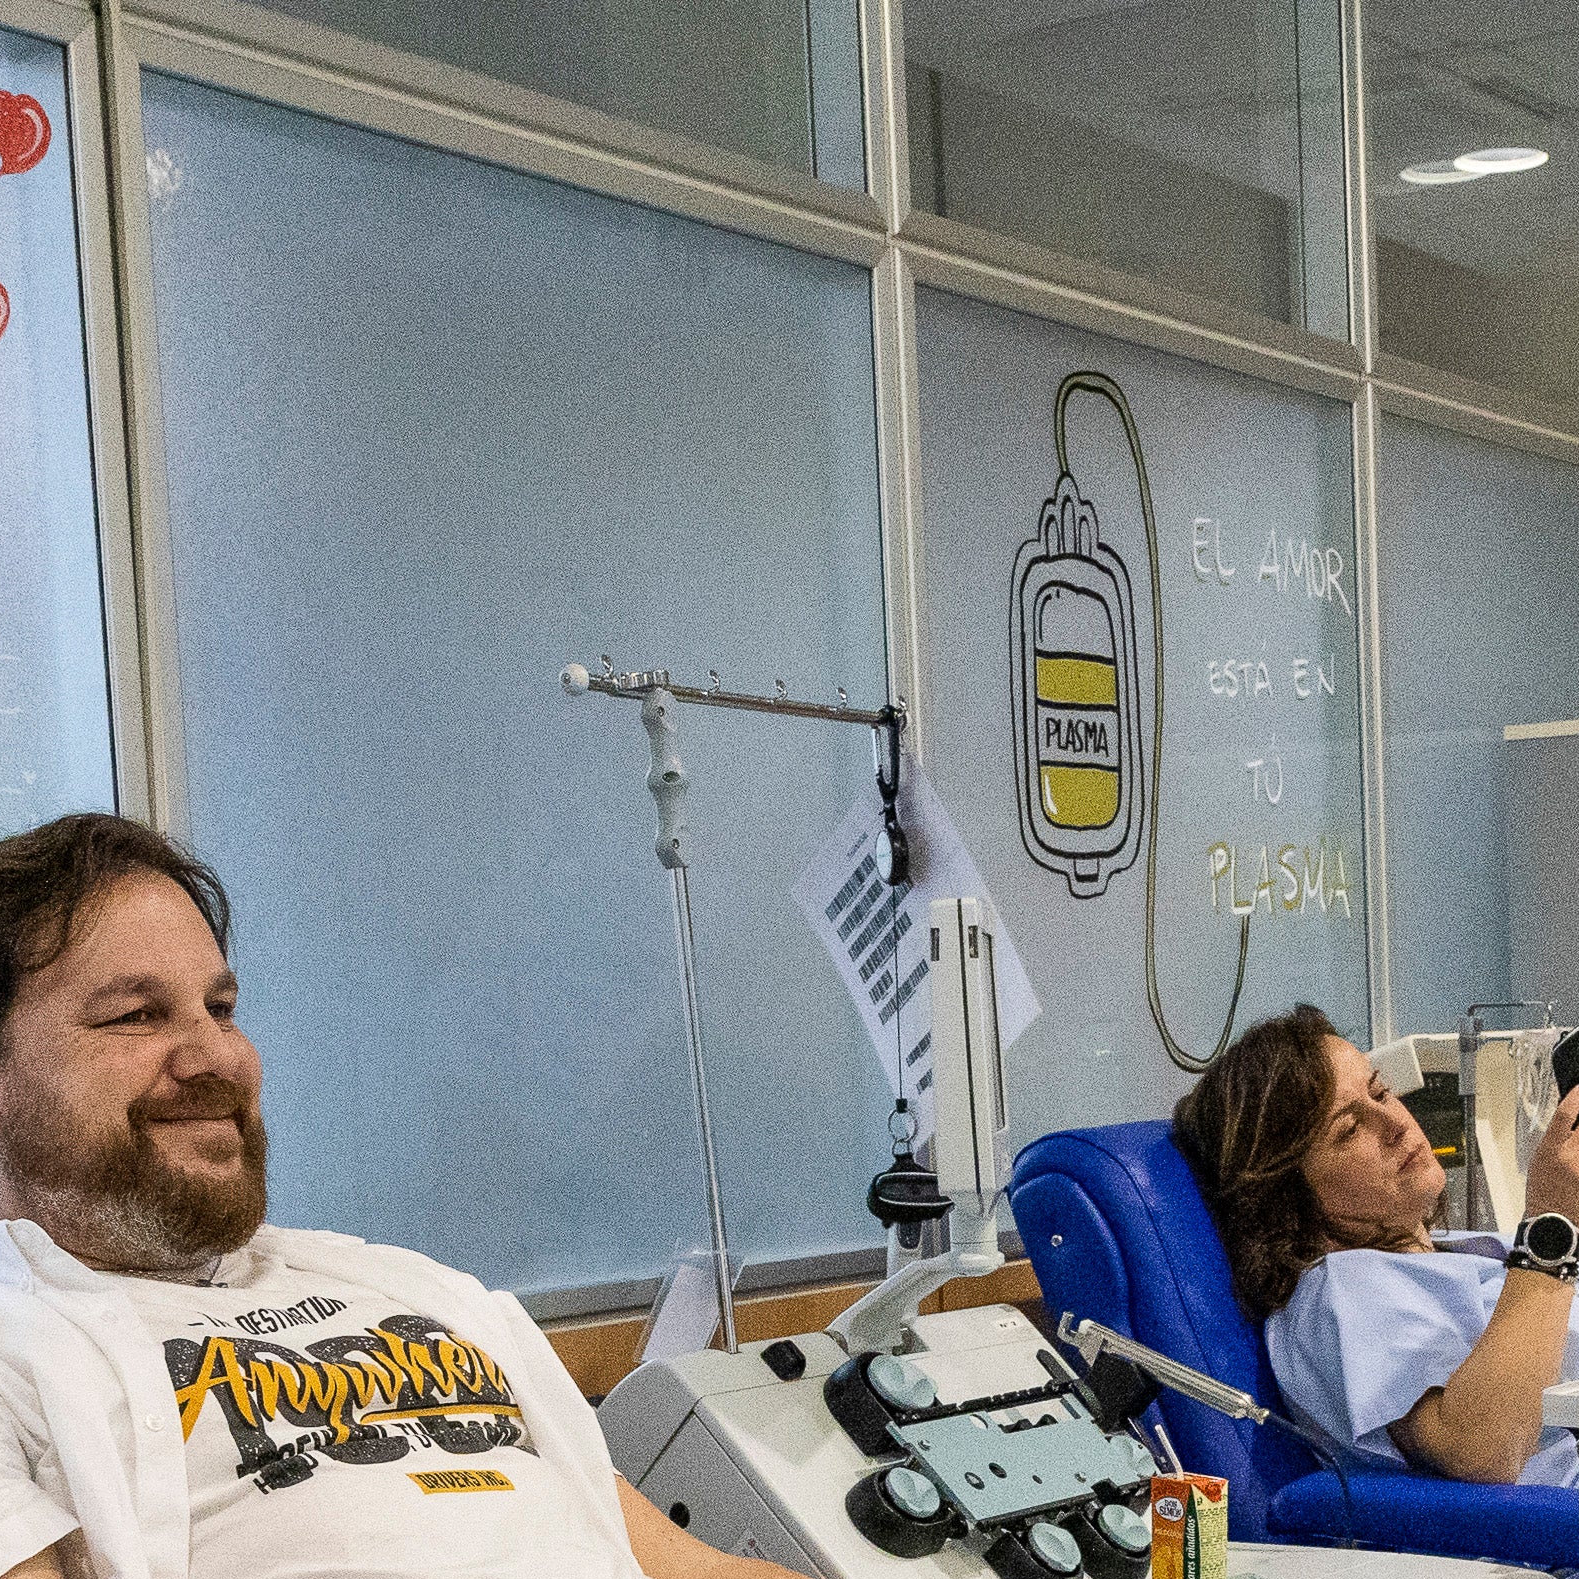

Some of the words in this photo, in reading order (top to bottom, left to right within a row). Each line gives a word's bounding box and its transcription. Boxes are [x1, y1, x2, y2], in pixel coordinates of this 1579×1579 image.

[1191, 516, 1236, 584] EL
[1257, 529, 1353, 616] AMOR
[1291, 650, 1336, 698] EN
[1044, 716, 1110, 758] PLASMA
[1206, 840, 1353, 918] PLASMA
[417, 1471, 478, 1493] DRIVERS
